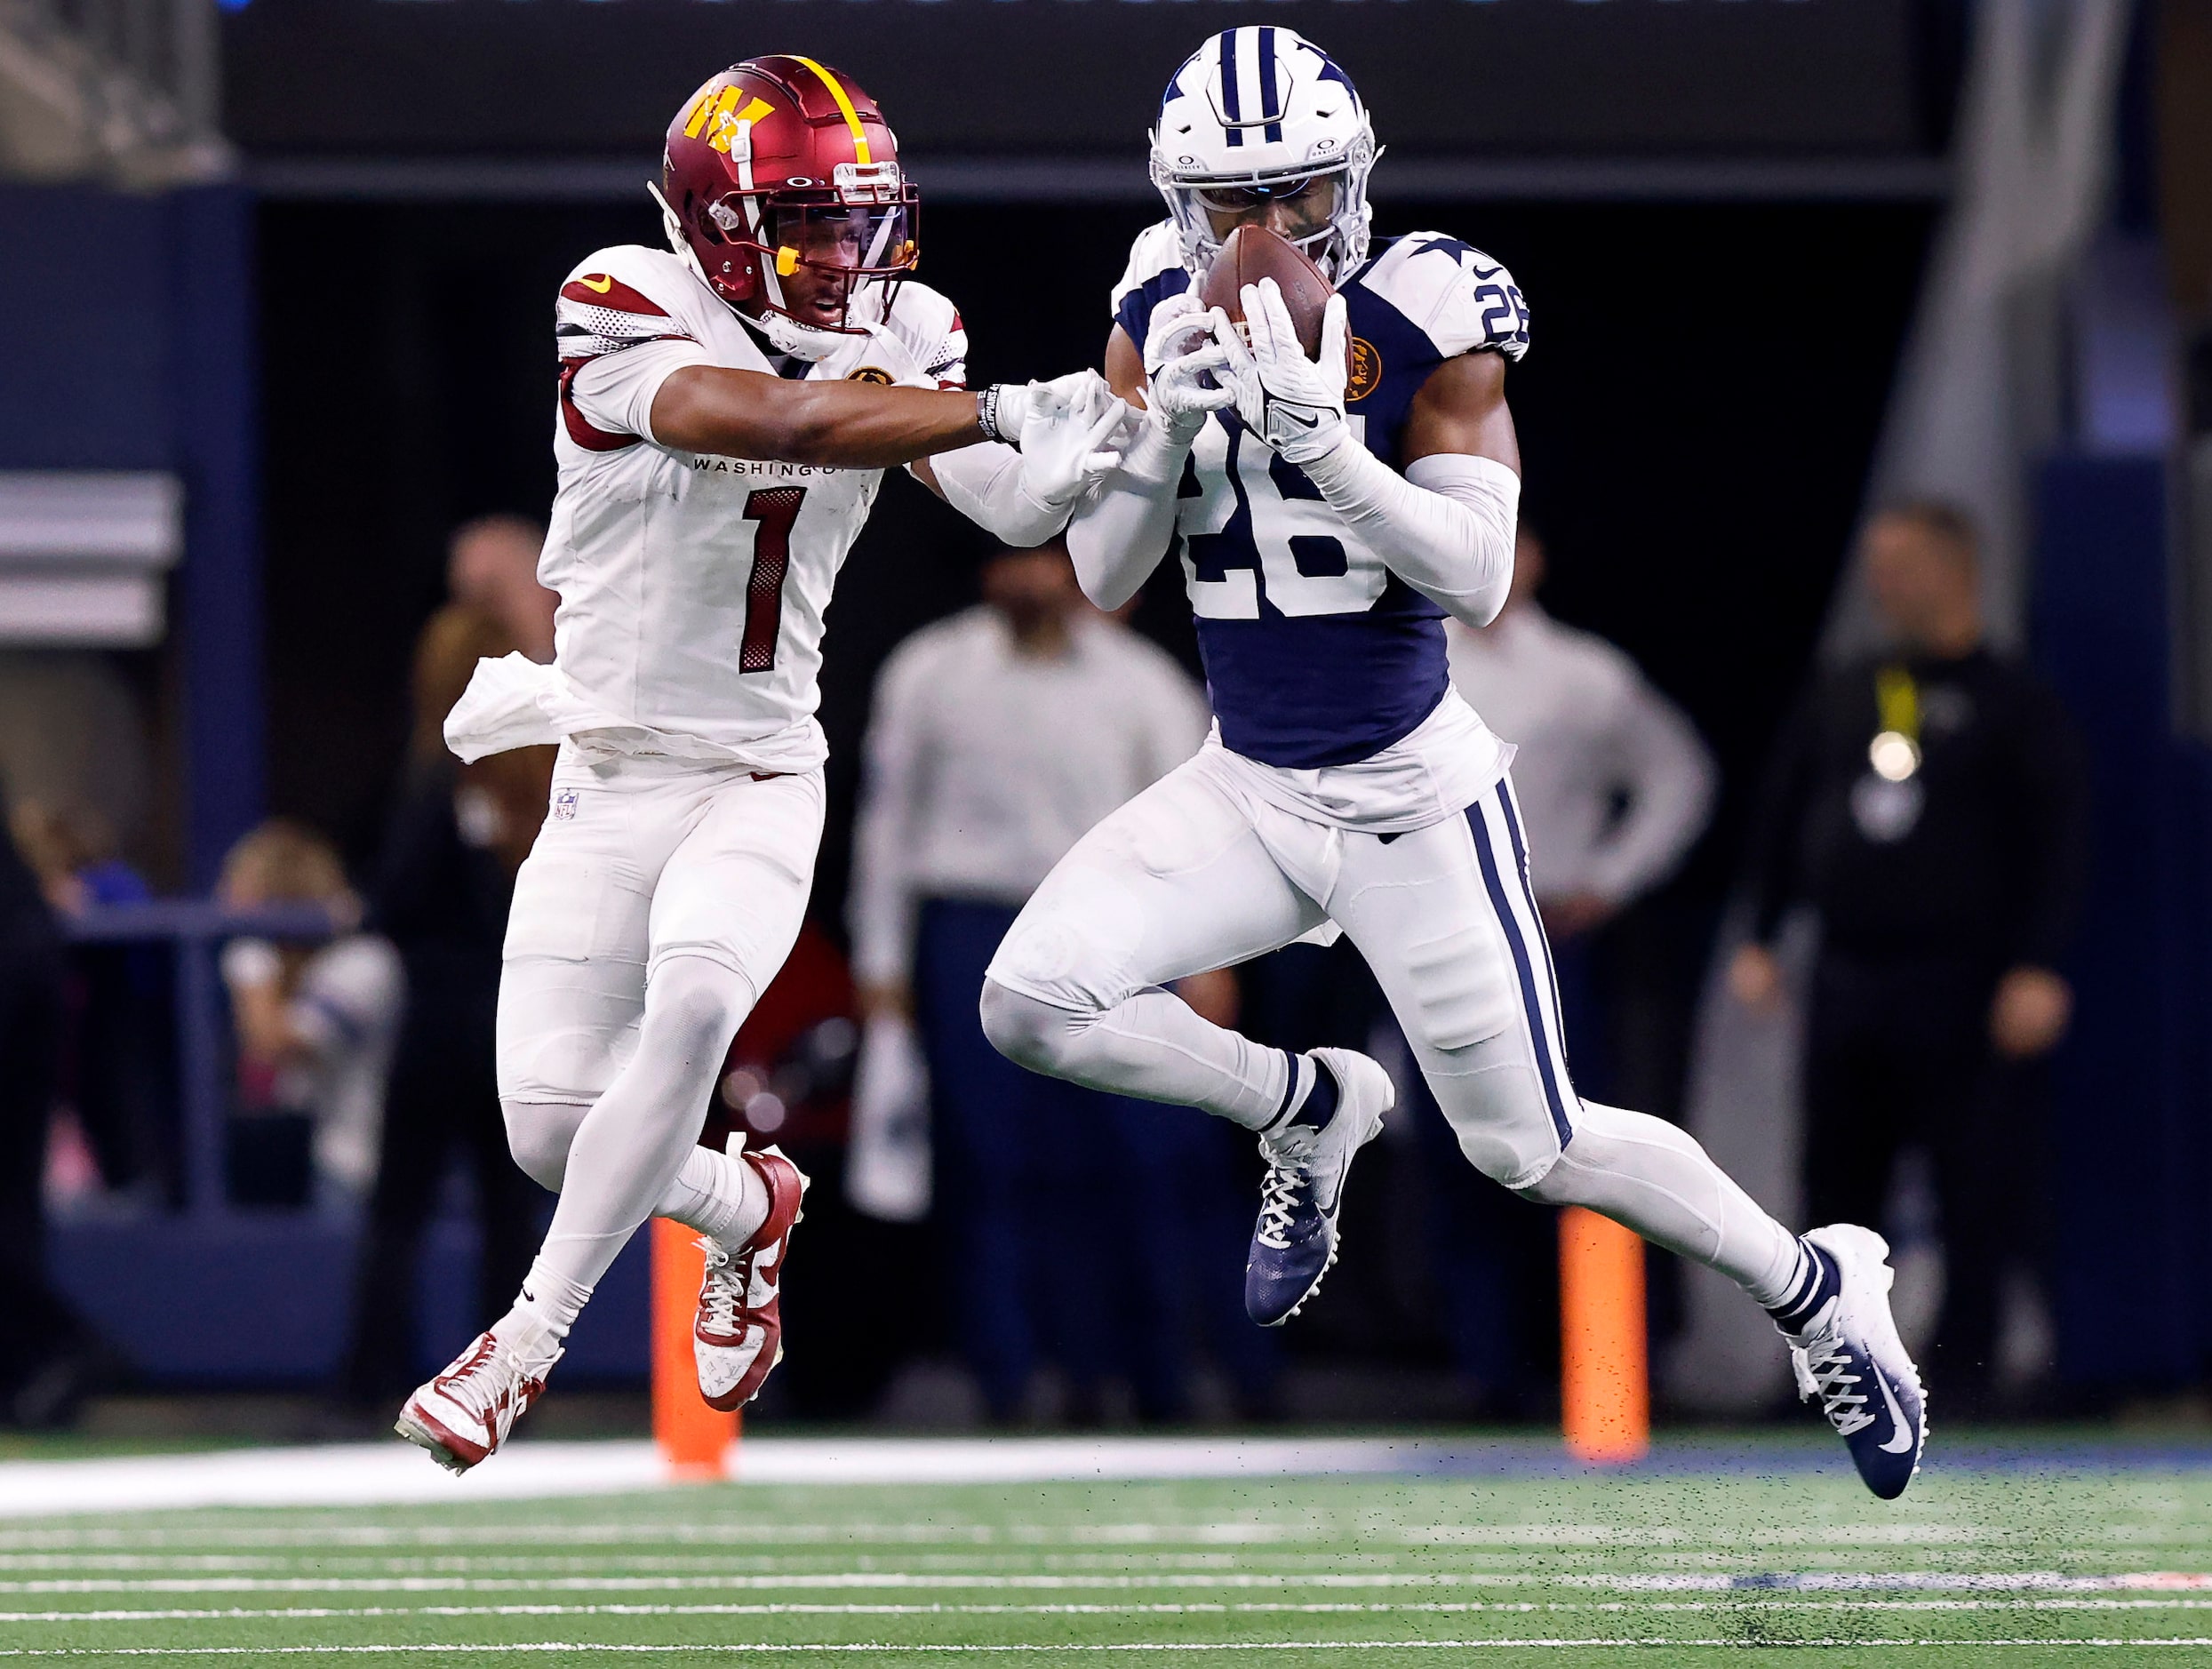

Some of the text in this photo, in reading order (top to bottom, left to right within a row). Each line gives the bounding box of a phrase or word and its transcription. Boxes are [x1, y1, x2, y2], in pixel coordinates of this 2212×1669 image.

[1473, 283, 1529, 344] 26
[739, 485, 808, 675] 1
[1175, 410, 1388, 620] 26
